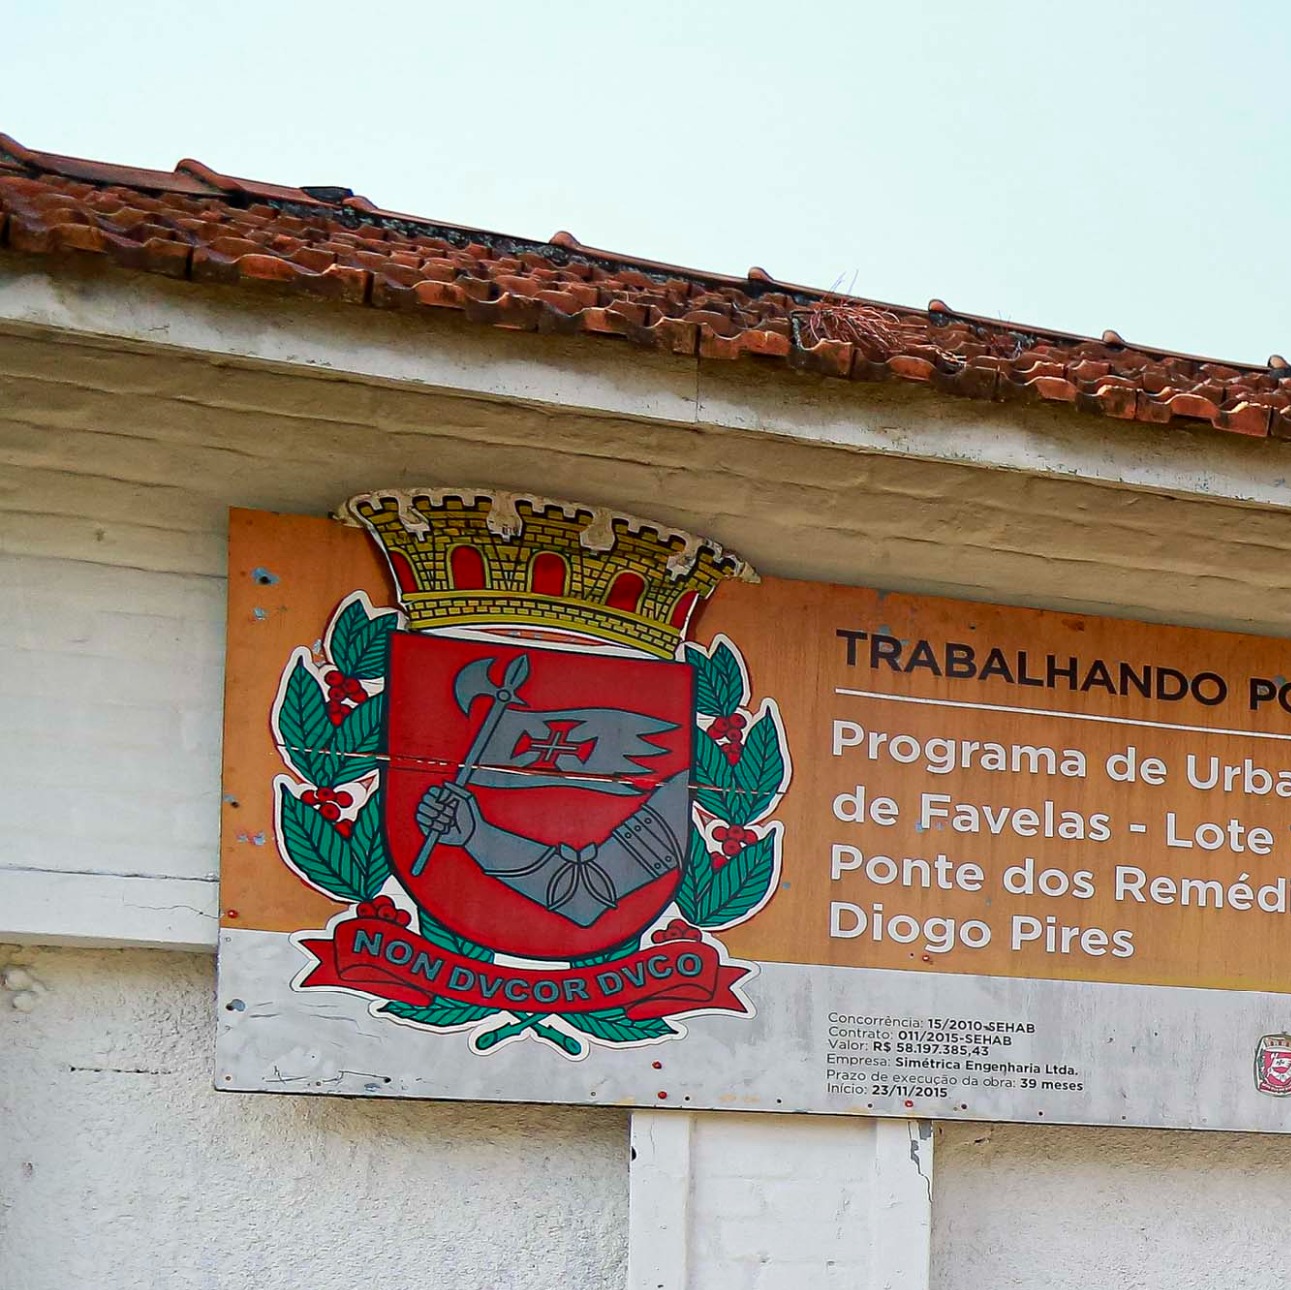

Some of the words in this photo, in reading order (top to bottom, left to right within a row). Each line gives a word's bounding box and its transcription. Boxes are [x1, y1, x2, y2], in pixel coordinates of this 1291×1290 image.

[836, 628, 1228, 706] TRABALHANDO
[832, 720, 1087, 777] Programa
[1106, 746, 1167, 786] de
[831, 785, 899, 827] de
[921, 792, 1112, 842] Favelas
[1129, 824, 1147, 834] -
[1167, 813, 1274, 856] Lote
[830, 844, 985, 895] Ponte
[1003, 857, 1095, 900] dos
[830, 900, 992, 953] Diogo
[1011, 915, 1134, 958] Pires
[352, 929, 443, 981] NON
[446, 964, 590, 1003] DVCOR
[598, 952, 704, 996] DVCO
[828, 1012, 923, 1029] Concorrência:
[928, 1018, 1036, 1034] 15/2010-SEHAB
[828, 1026, 894, 1040] Contrato:
[898, 1030, 1012, 1046] 011/2015-SEHAB
[827, 1053, 891, 1067] Empresa:
[895, 1056, 961, 1070] Simétrica
[965, 1060, 1041, 1075] Engenharia
[1045, 1064, 1079, 1076] Ltda.
[828, 1039, 868, 1051] Valor:
[873, 1041, 891, 1053] R$
[896, 1042, 989, 1057] 58.197.385,43
[826, 1069, 866, 1081] Prazo
[870, 1071, 889, 1082] de
[892, 1074, 957, 1086] execução
[962, 1076, 978, 1086] da
[983, 1076, 1016, 1088] obra:
[1020, 1078, 1037, 1089] 39
[1041, 1081, 1084, 1091] meses
[827, 1082, 867, 1095] Início:
[871, 1084, 948, 1098] 23/11/2015
